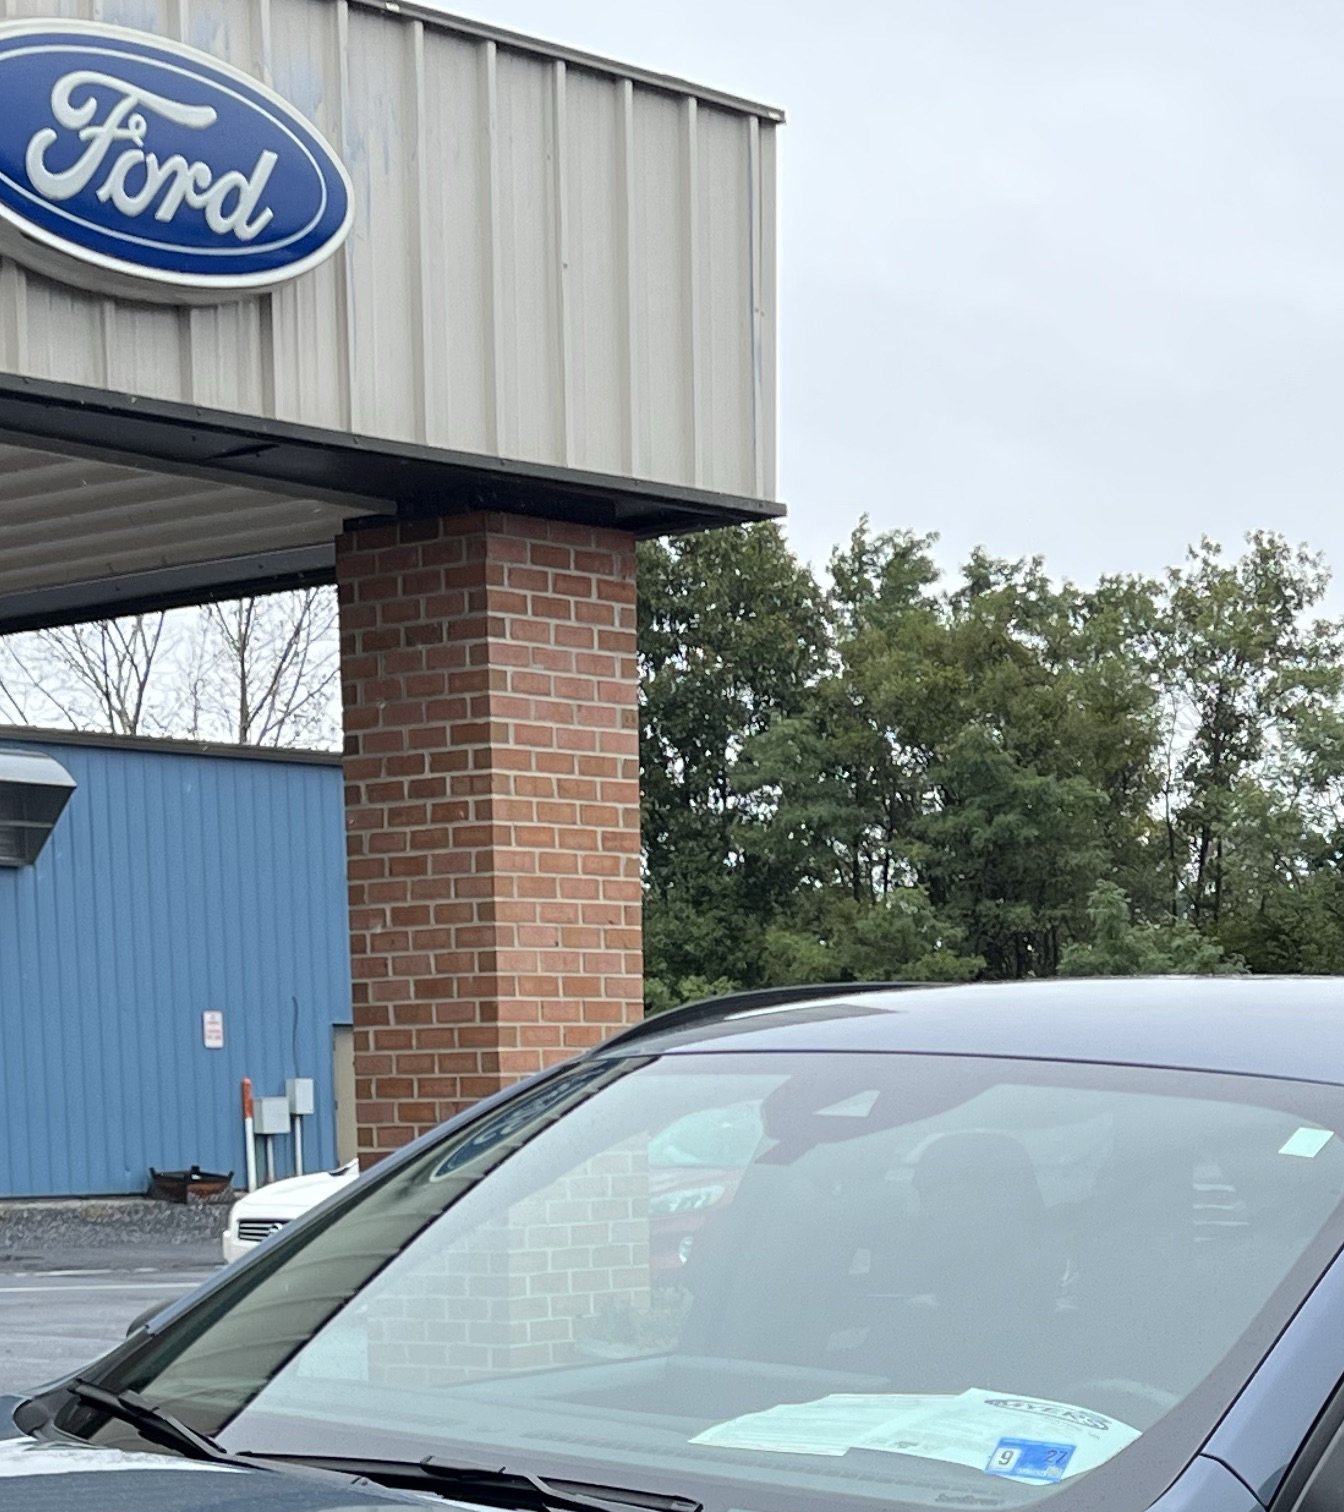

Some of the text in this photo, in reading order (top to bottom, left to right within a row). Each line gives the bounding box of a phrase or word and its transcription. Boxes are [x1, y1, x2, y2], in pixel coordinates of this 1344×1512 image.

[25, 70, 278, 241] Ford
[998, 1449, 1068, 1466] 9 27
